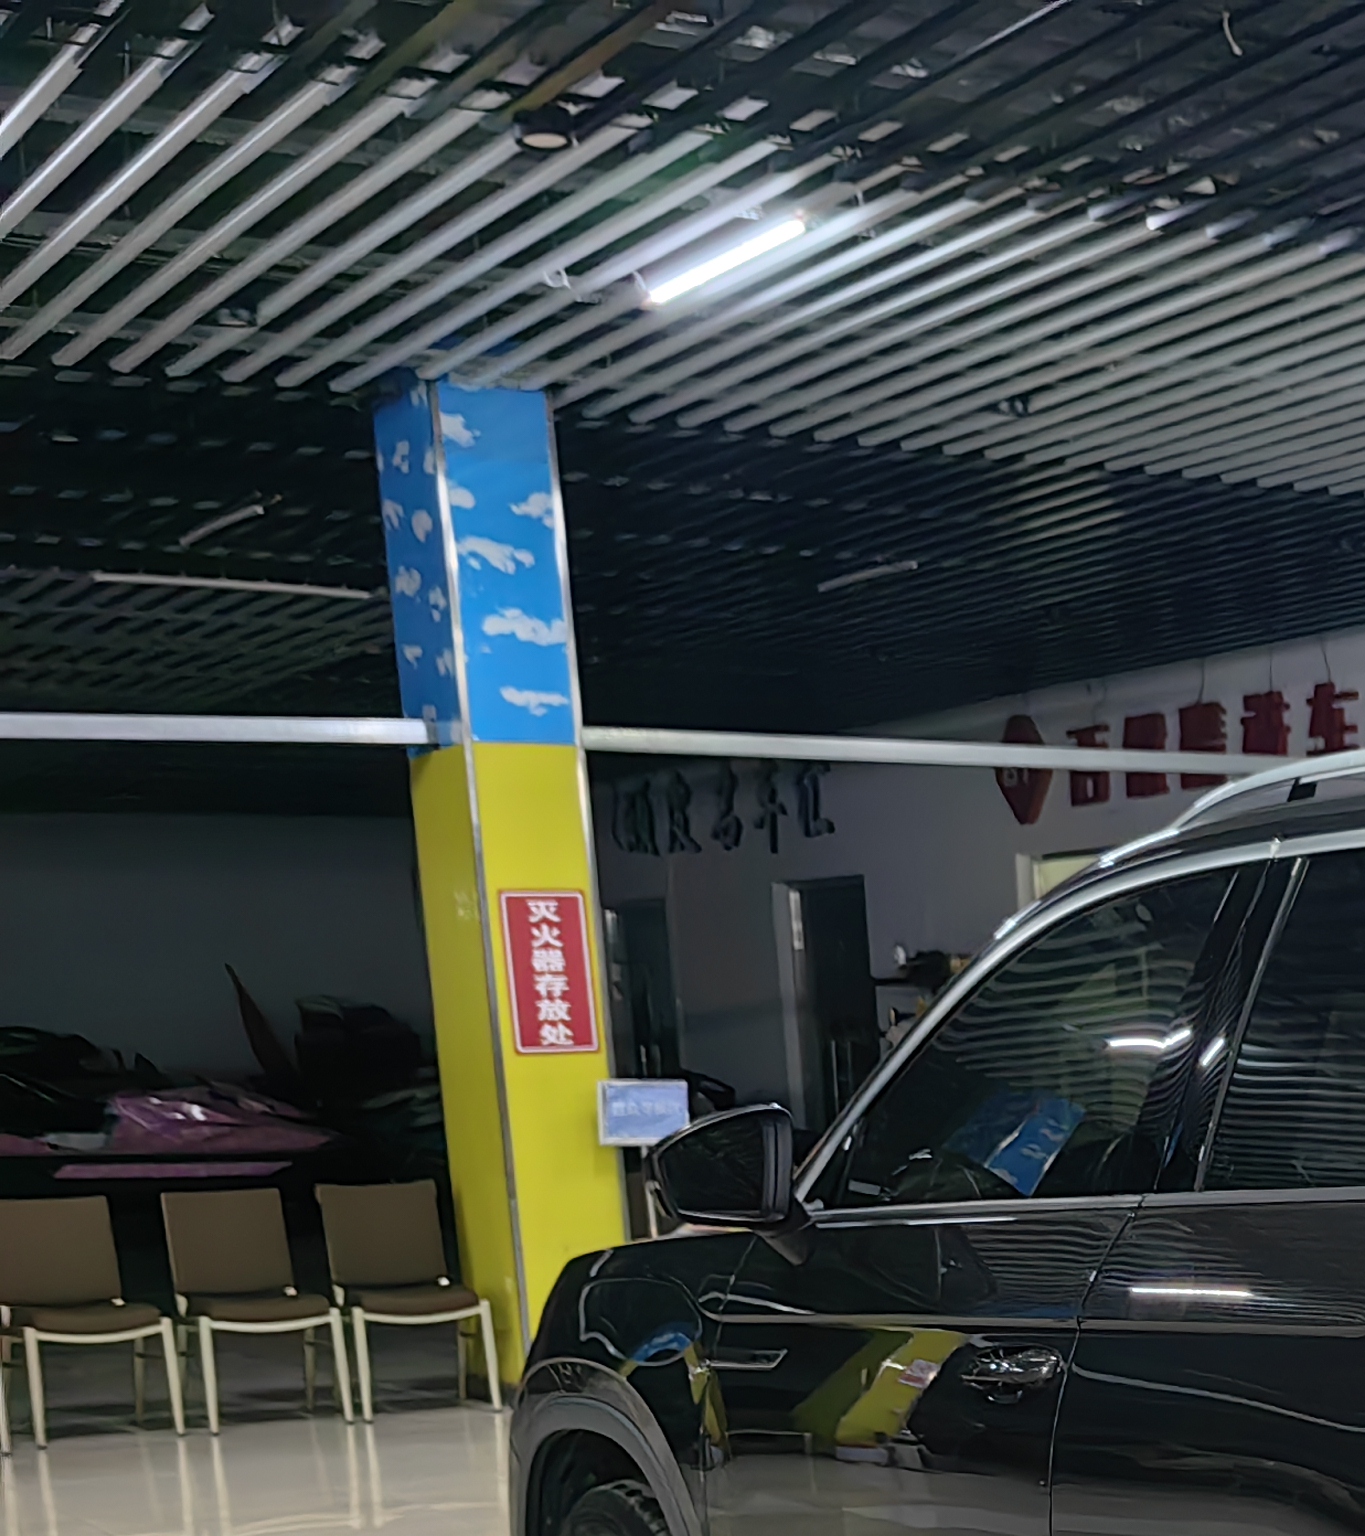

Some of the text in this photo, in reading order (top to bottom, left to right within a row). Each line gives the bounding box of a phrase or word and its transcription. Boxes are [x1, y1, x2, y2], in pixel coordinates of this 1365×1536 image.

[527, 899, 574, 1045] 灭火器存放处
